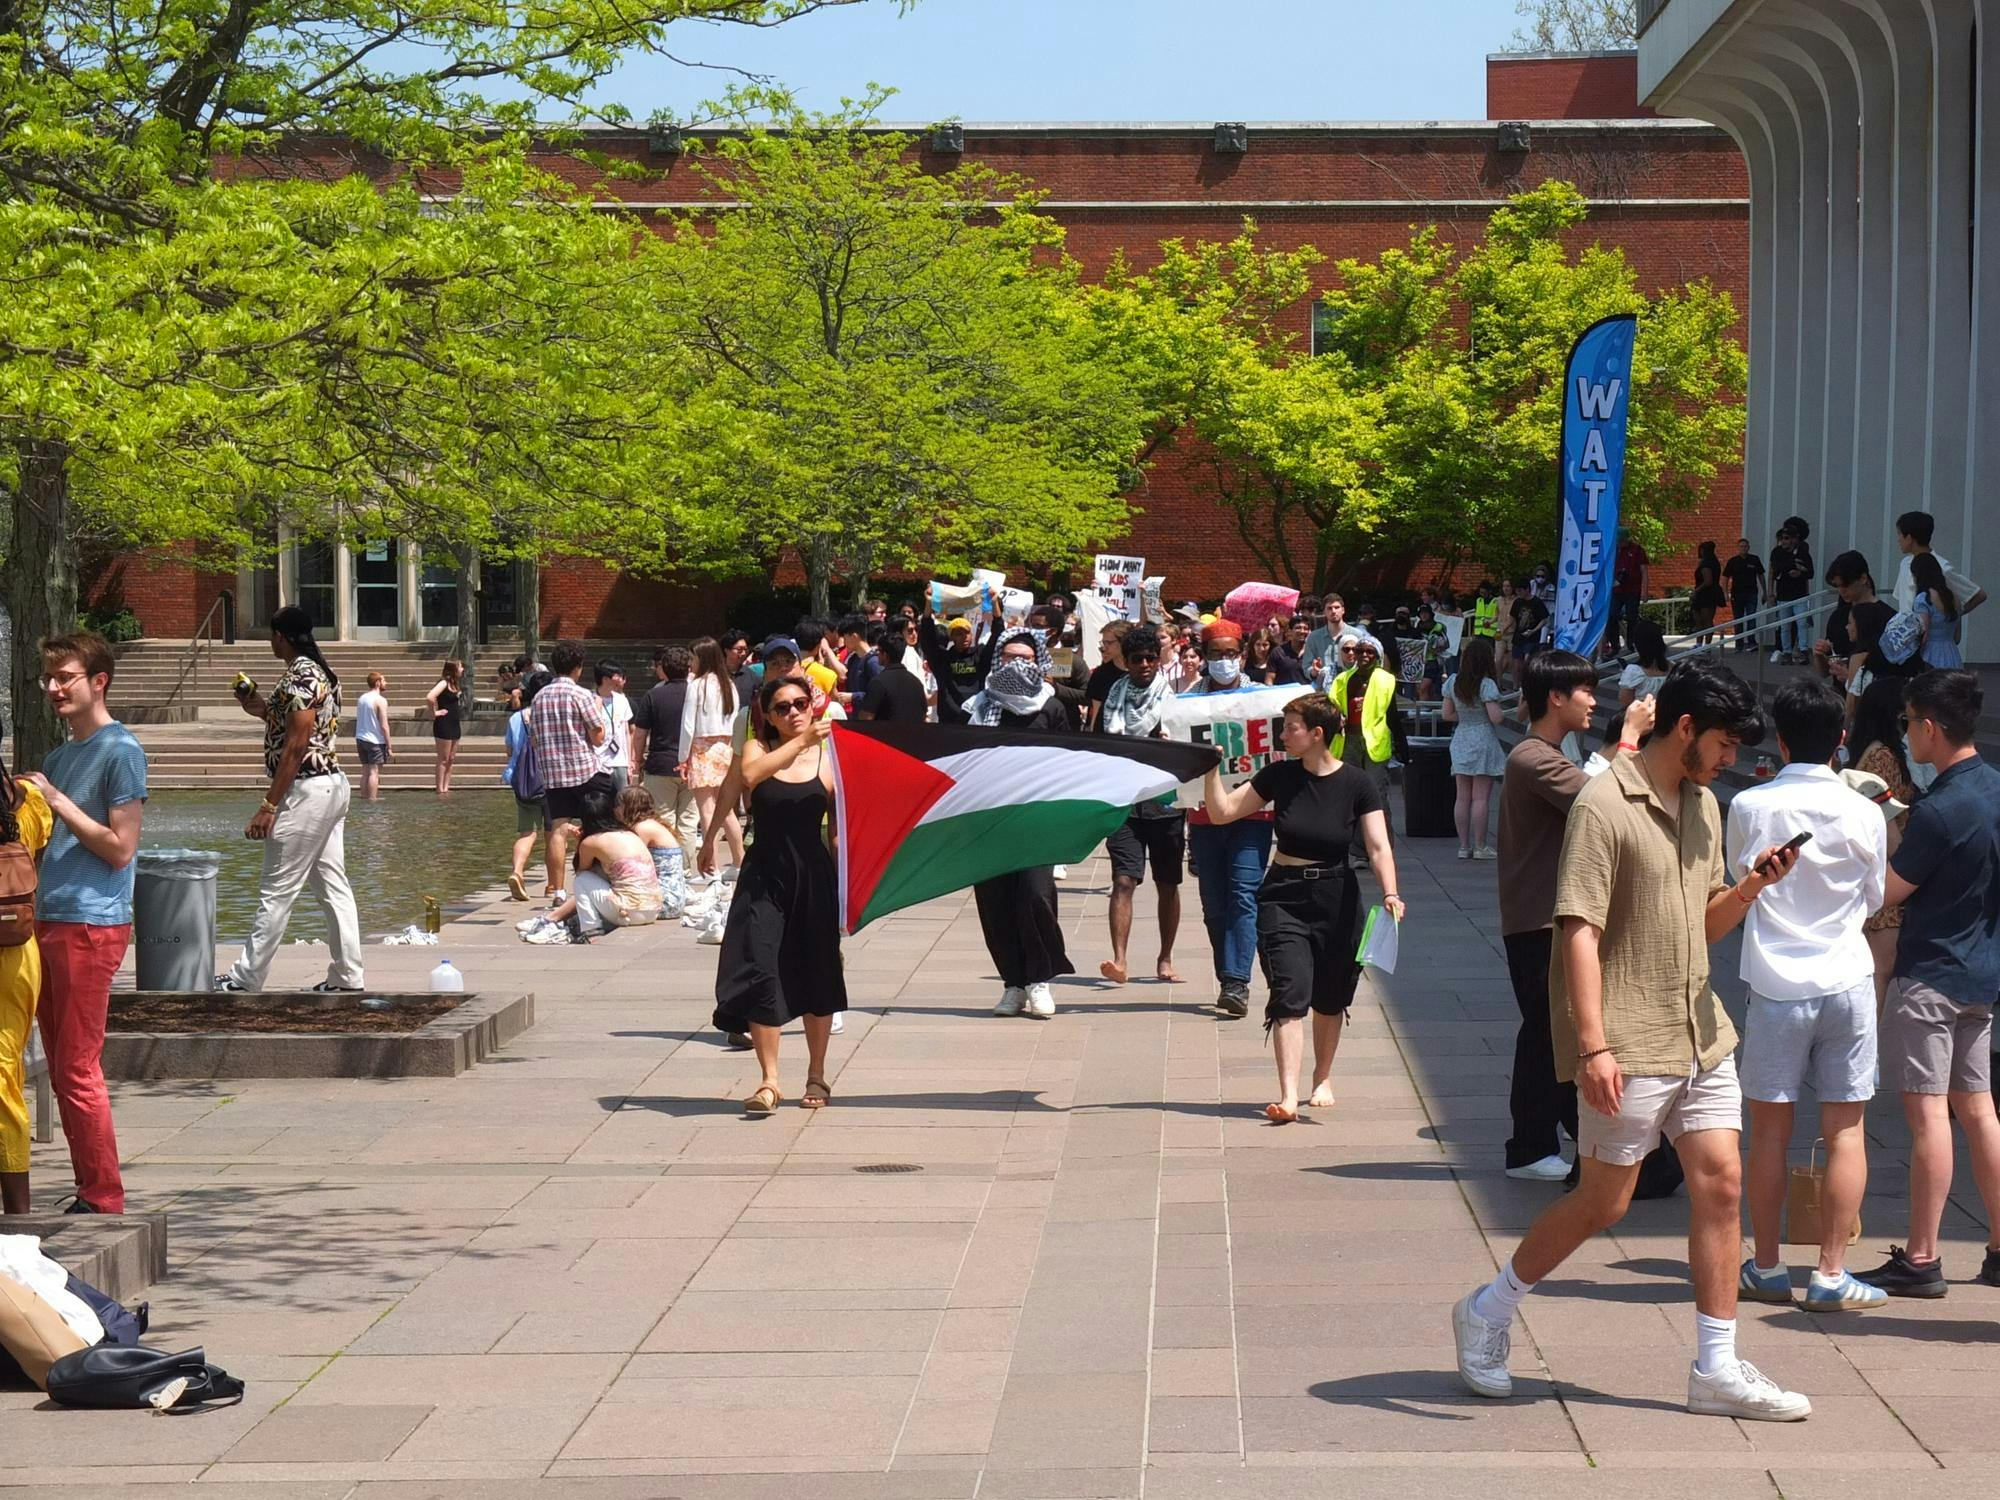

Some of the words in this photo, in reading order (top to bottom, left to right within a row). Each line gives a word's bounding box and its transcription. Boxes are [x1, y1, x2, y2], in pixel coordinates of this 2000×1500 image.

[1571, 376, 1622, 622] WATER
[1099, 558, 1120, 571] HOW
[1122, 560, 1142, 573] MANY
[1109, 573, 1129, 587] KIDS
[1099, 587, 1113, 598] DID
[1122, 587, 1136, 599] YOU
